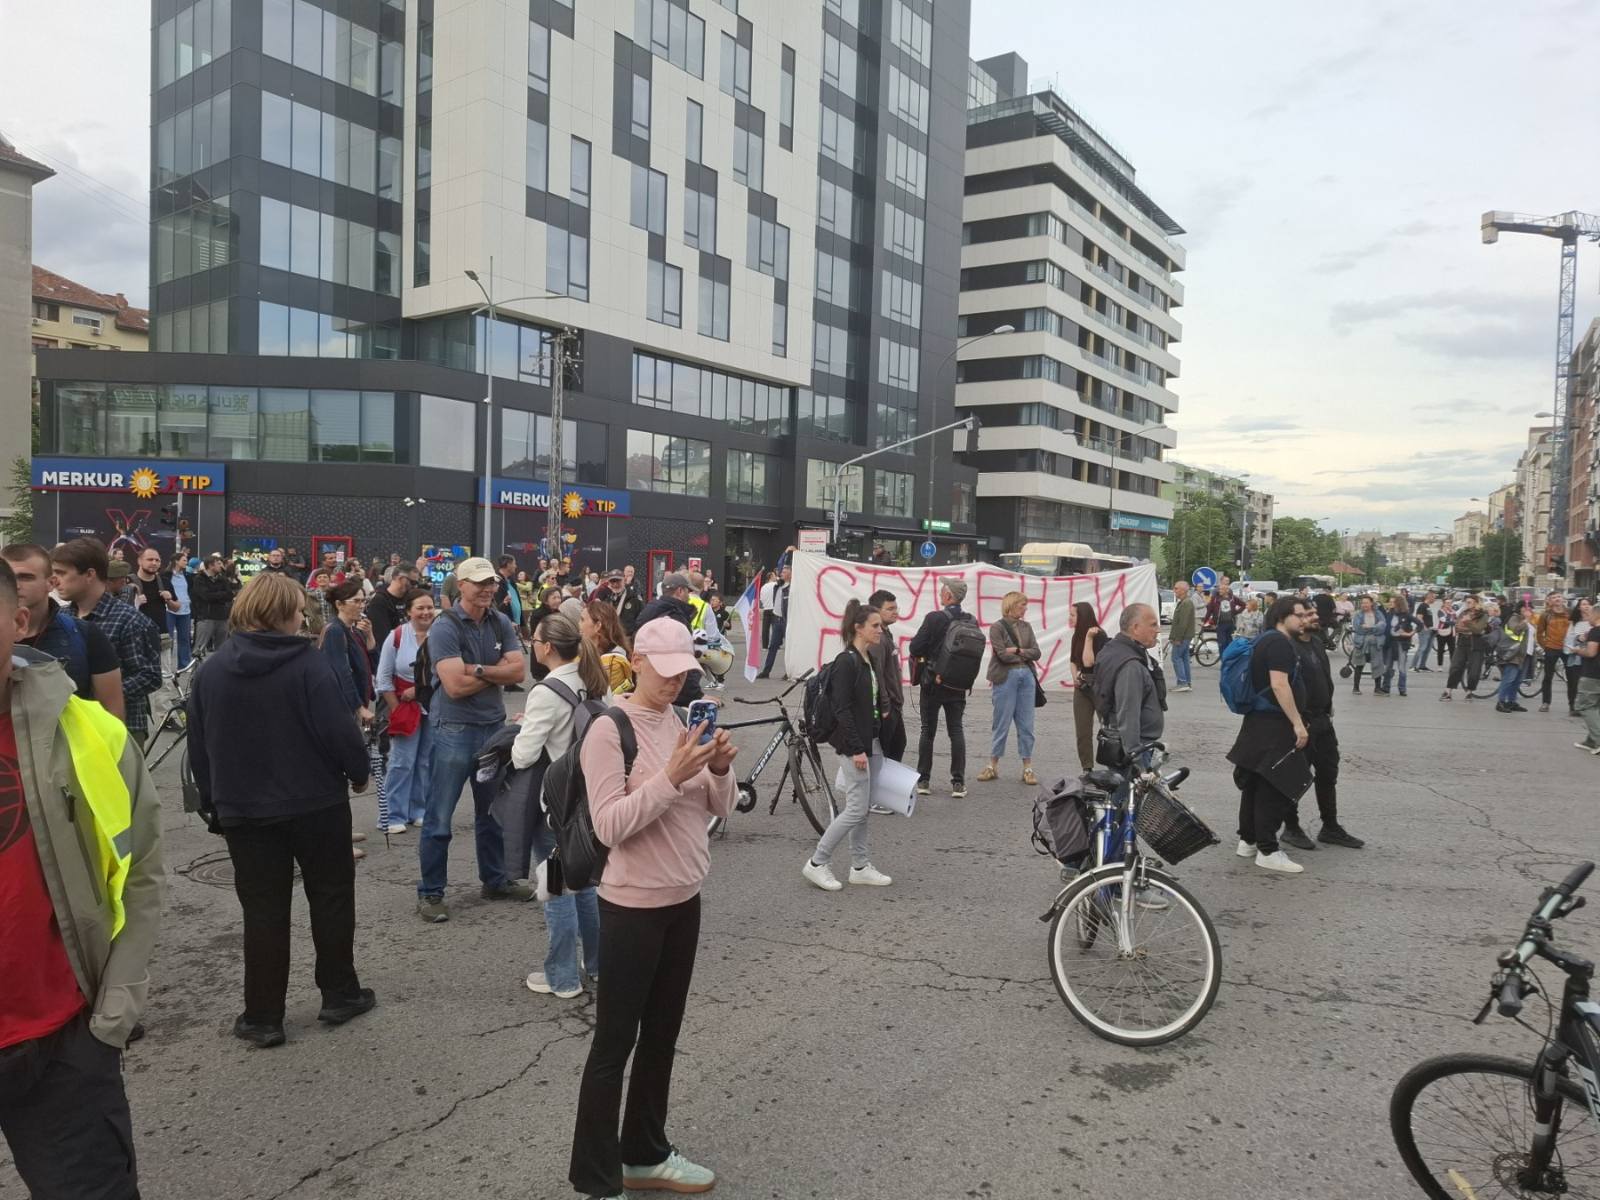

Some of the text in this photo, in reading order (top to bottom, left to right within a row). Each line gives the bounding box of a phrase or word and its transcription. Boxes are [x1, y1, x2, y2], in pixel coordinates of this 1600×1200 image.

[42, 470, 124, 487] MERKUR
[501, 490, 553, 507] MERKU
[751, 731, 783, 780] capriolo
